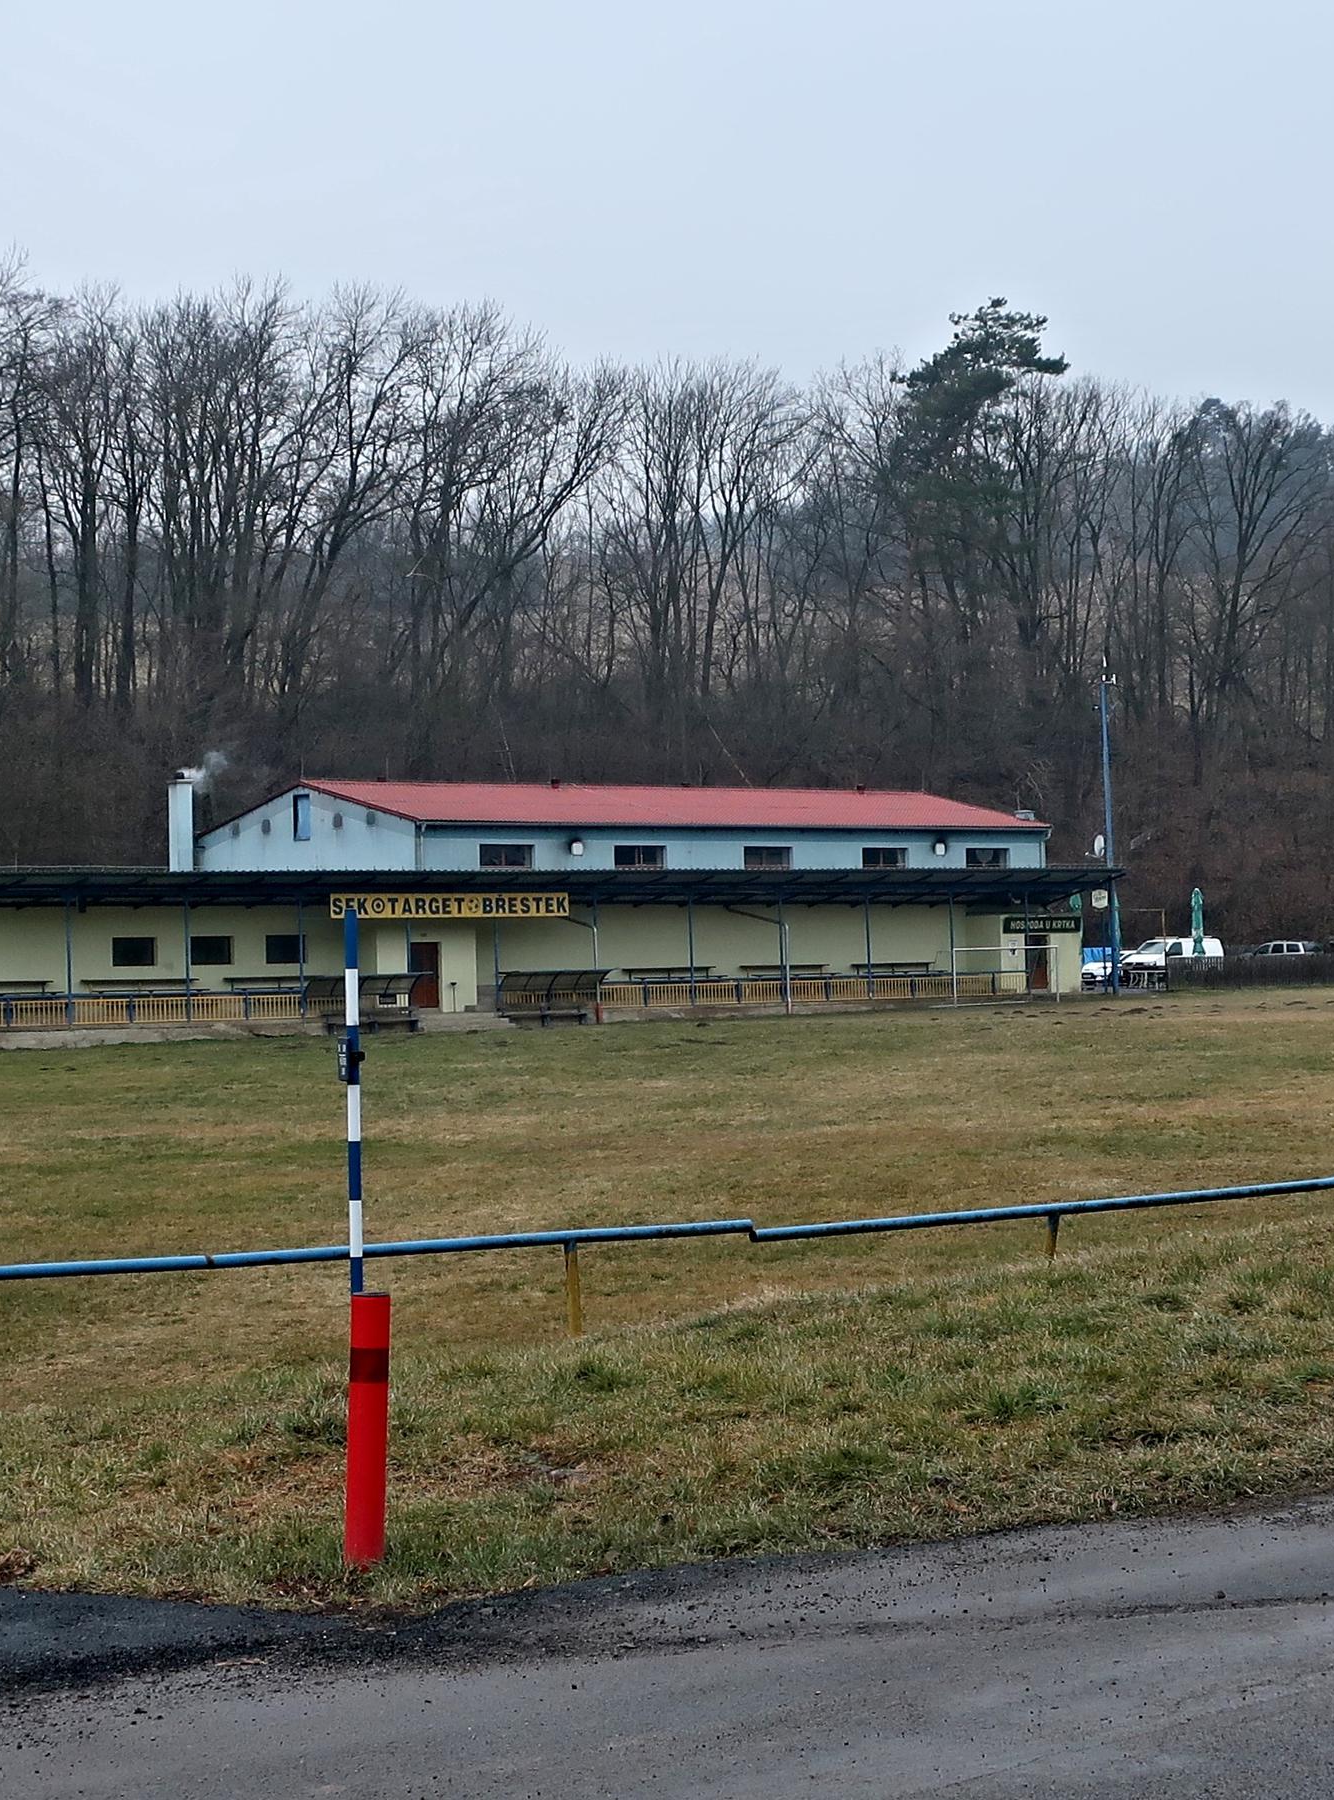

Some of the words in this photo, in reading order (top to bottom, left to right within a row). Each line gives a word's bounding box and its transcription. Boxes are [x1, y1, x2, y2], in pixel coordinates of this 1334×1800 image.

[387, 896, 465, 915] TARGET
[482, 894, 568, 914] BŘESTEK
[1045, 919, 1051, 930] U
